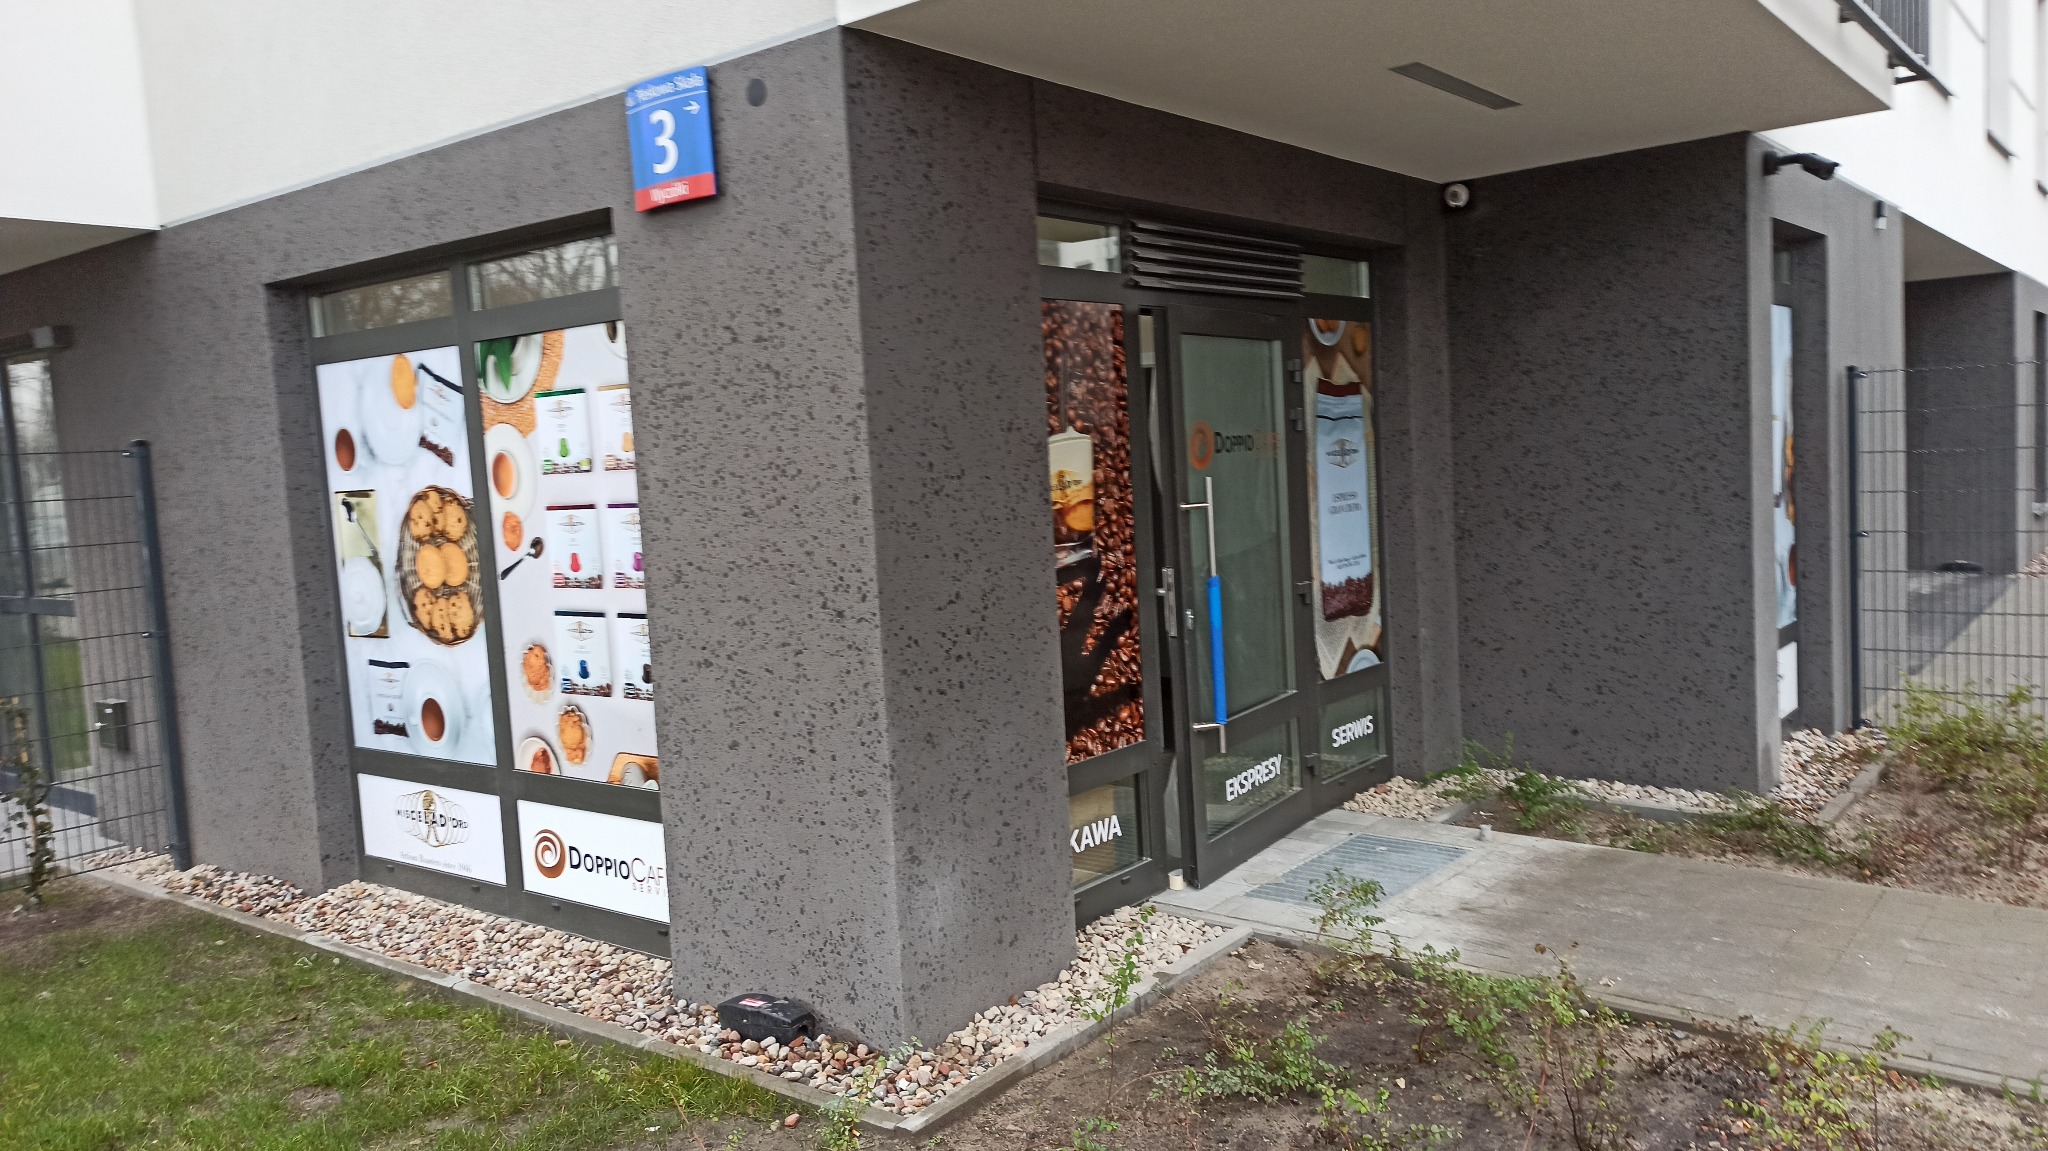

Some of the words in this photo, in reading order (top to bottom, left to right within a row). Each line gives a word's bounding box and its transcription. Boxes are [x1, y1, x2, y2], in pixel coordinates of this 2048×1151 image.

[650, 109, 679, 174] 3
[1332, 715, 1374, 748] SERWIS
[1225, 754, 1282, 802] EKSPRESY
[1069, 814, 1122, 853] KAWA
[568, 845, 665, 887] DOPPIOCAF
